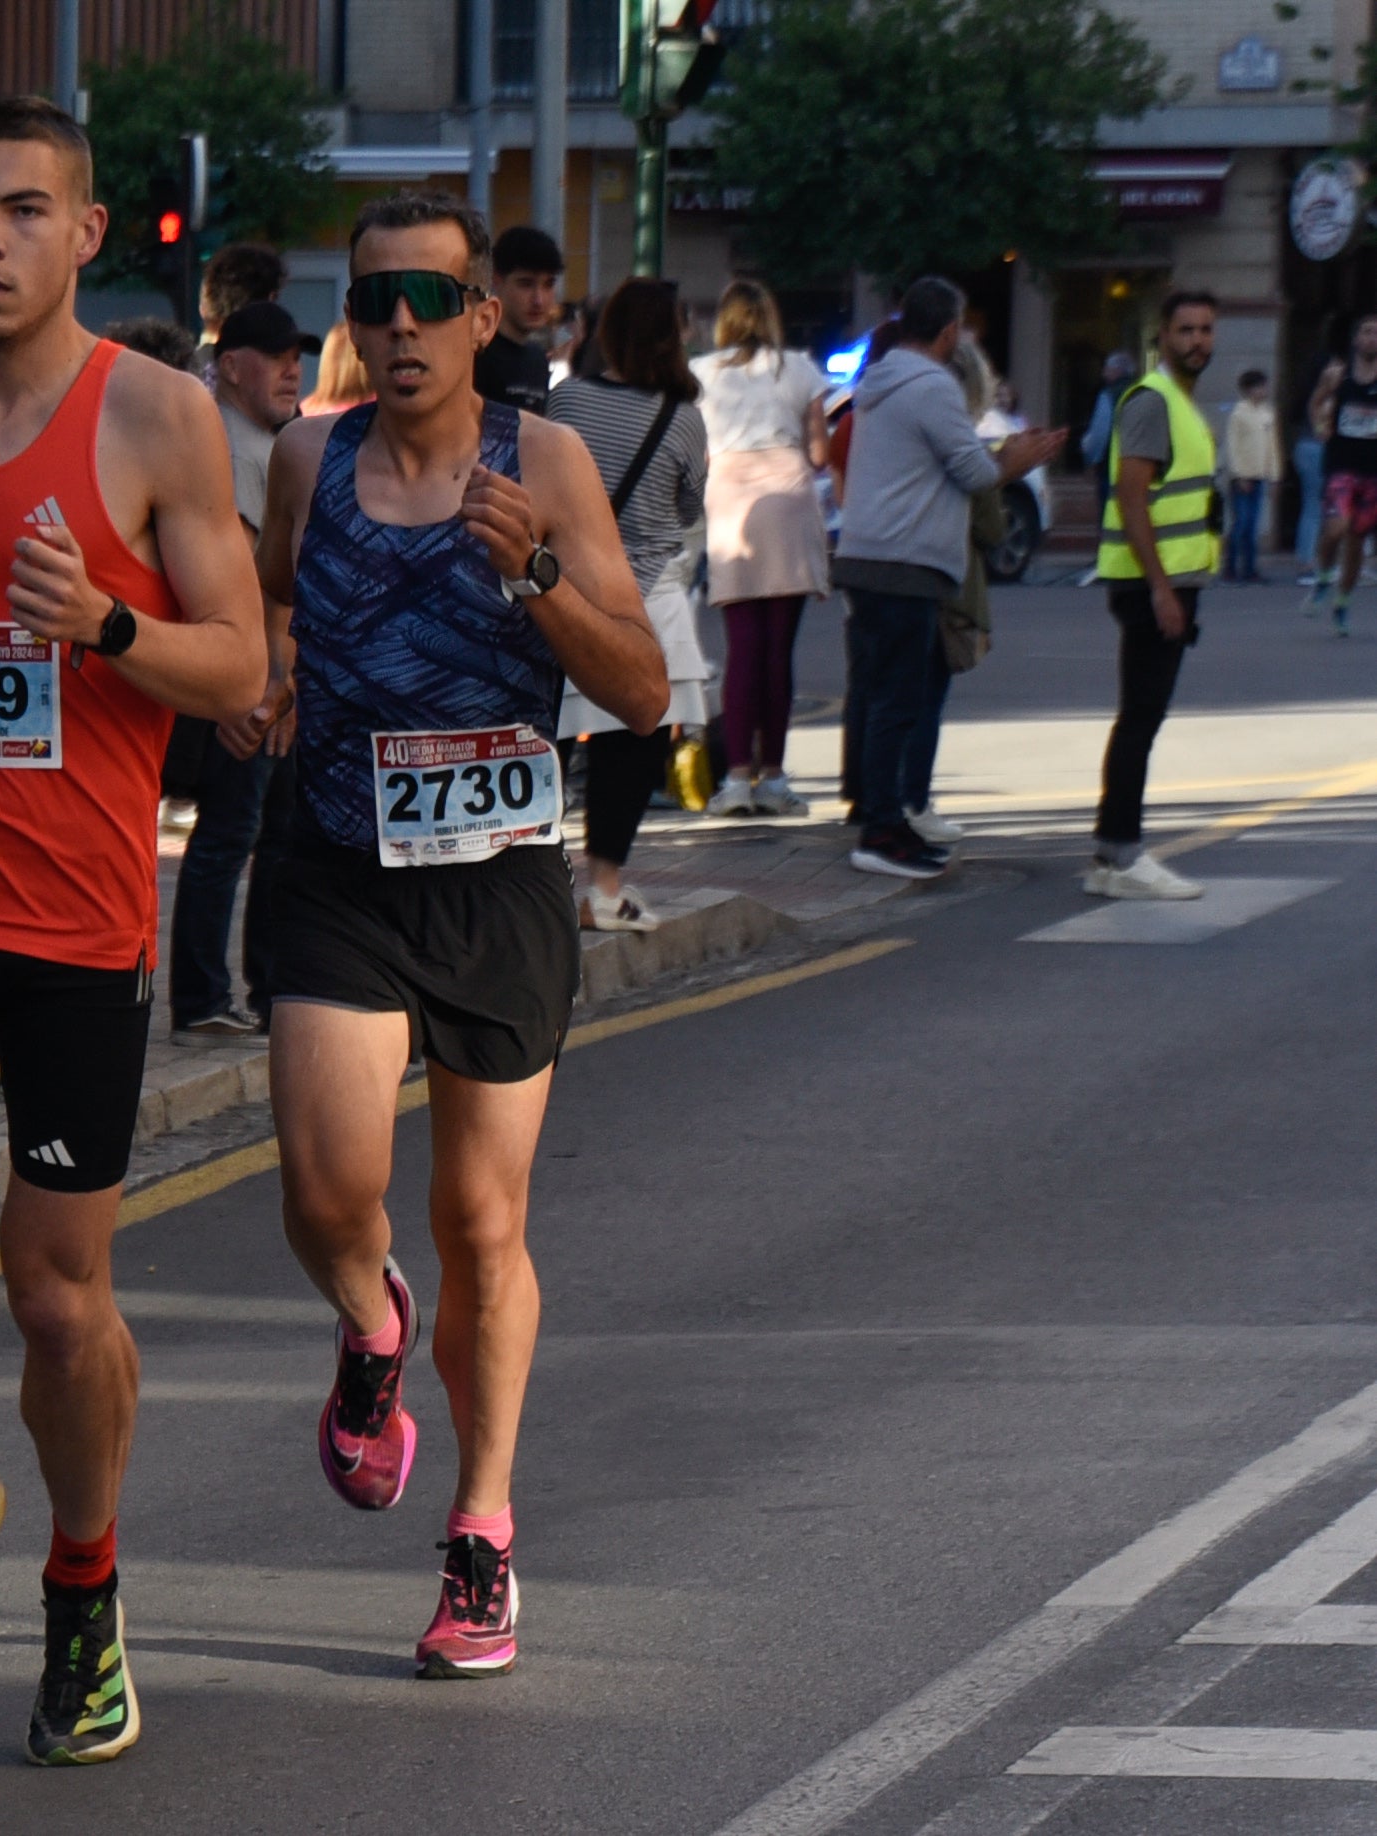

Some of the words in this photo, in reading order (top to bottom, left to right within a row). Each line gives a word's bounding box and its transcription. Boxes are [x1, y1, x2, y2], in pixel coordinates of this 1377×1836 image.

[11, 647, 32, 660] 2024
[383, 738, 410, 766] 40
[409, 743, 435, 756] MEDIA
[489, 748, 495, 757] 4
[495, 746, 516, 757] MAYO
[386, 761, 533, 822] 2730
[459, 822, 483, 835] LOPEZ
